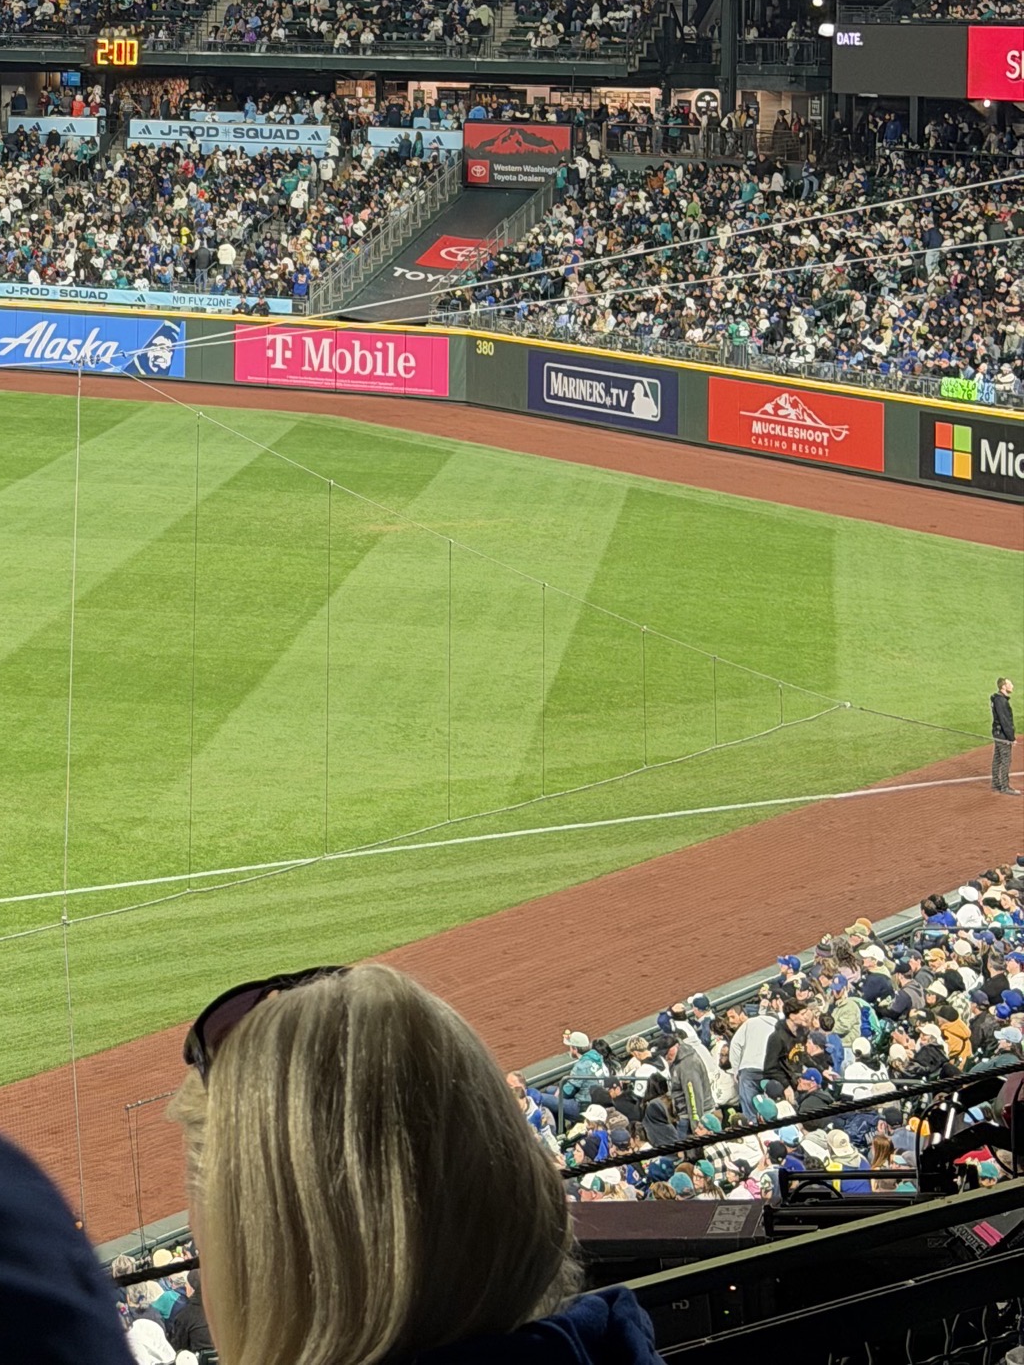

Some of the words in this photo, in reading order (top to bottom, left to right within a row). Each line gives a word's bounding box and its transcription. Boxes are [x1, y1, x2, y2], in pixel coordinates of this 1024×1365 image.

[96, 38, 139, 66] 2:00
[1005, 49, 1024, 80] S
[160, 124, 220, 138] J-ROD
[232, 127, 300, 141] SQUAD
[493, 163, 523, 173] Western
[493, 173, 517, 183] Toyota
[518, 174, 545, 183] Dealers
[5, 287, 50, 297] J-ROD
[59, 289, 108, 301] SQUAD
[172, 296, 186, 305] NO
[188, 297, 205, 306] FLY
[207, 298, 232, 307] ZONE
[266, 335, 293, 370] T
[301, 336, 416, 379] Mobile
[476, 339, 494, 356] 380
[550, 371, 605, 405] MARINERS
[610, 387, 628, 408] TV
[751, 420, 830, 446] MUCKLESHOOT
[751, 436, 787, 450] CASINO
[791, 443, 830, 457] RESORT
